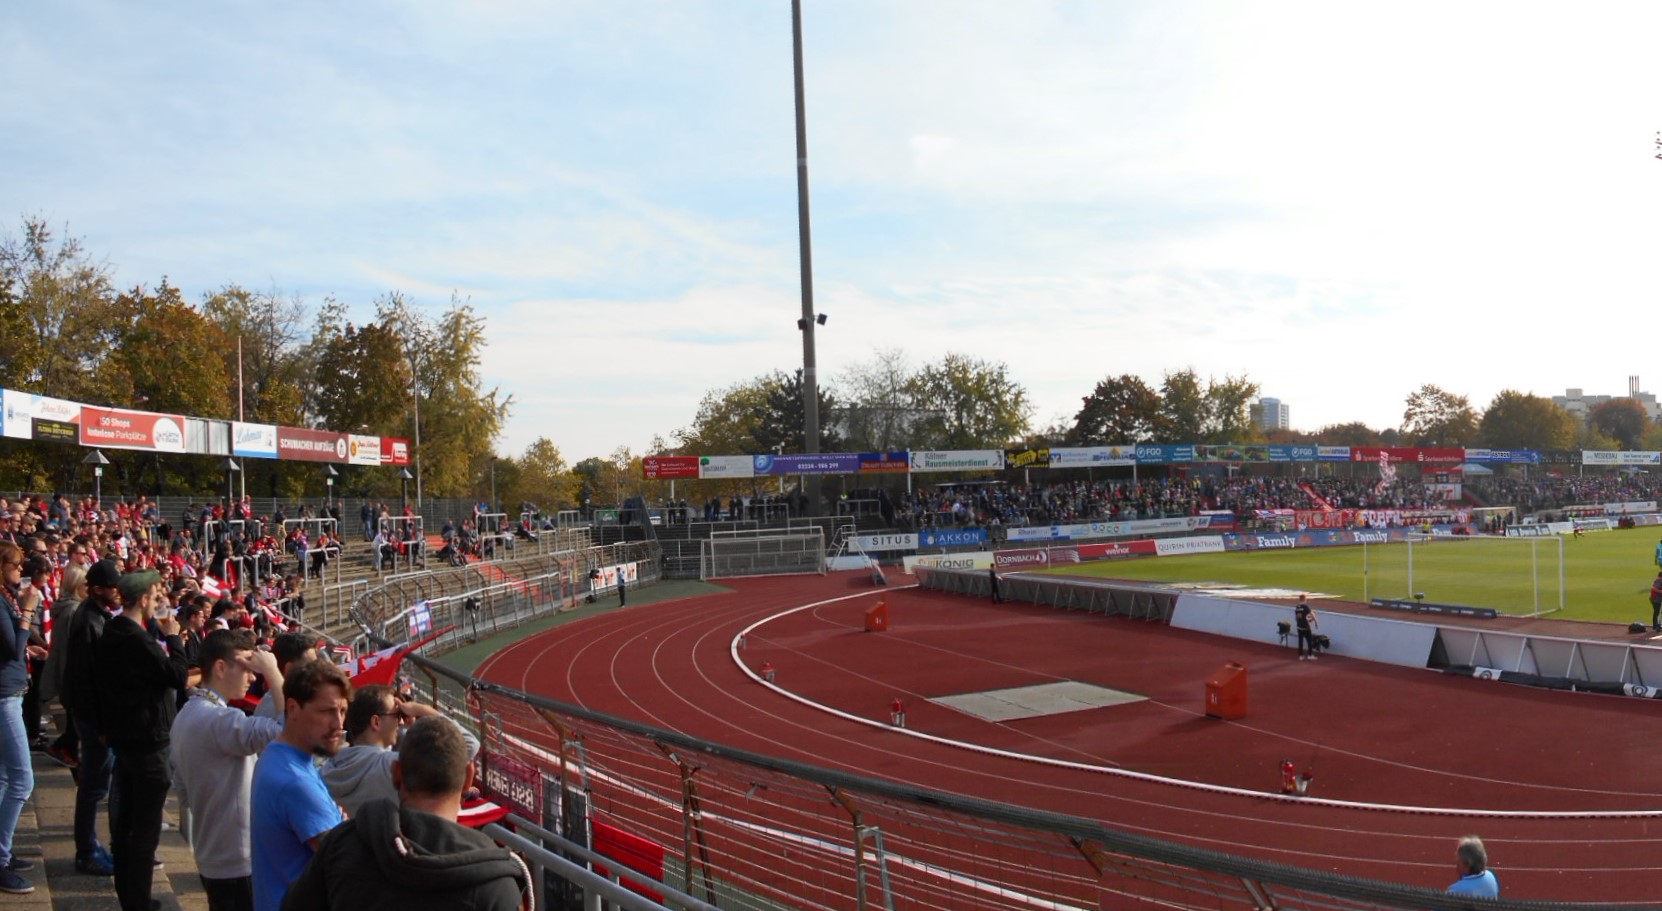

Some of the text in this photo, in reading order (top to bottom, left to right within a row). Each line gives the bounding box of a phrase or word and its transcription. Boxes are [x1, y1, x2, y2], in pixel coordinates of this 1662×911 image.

[111, 418, 131, 429] Shops
[1145, 448, 1162, 456] FGO
[925, 459, 988, 468] Hausmeisterdienst
[872, 535, 911, 545] SITUS
[939, 532, 979, 544] AKKON
[1257, 536, 1296, 548] Family
[1353, 531, 1388, 543] Family
[996, 553, 1035, 564] DORNBACH
